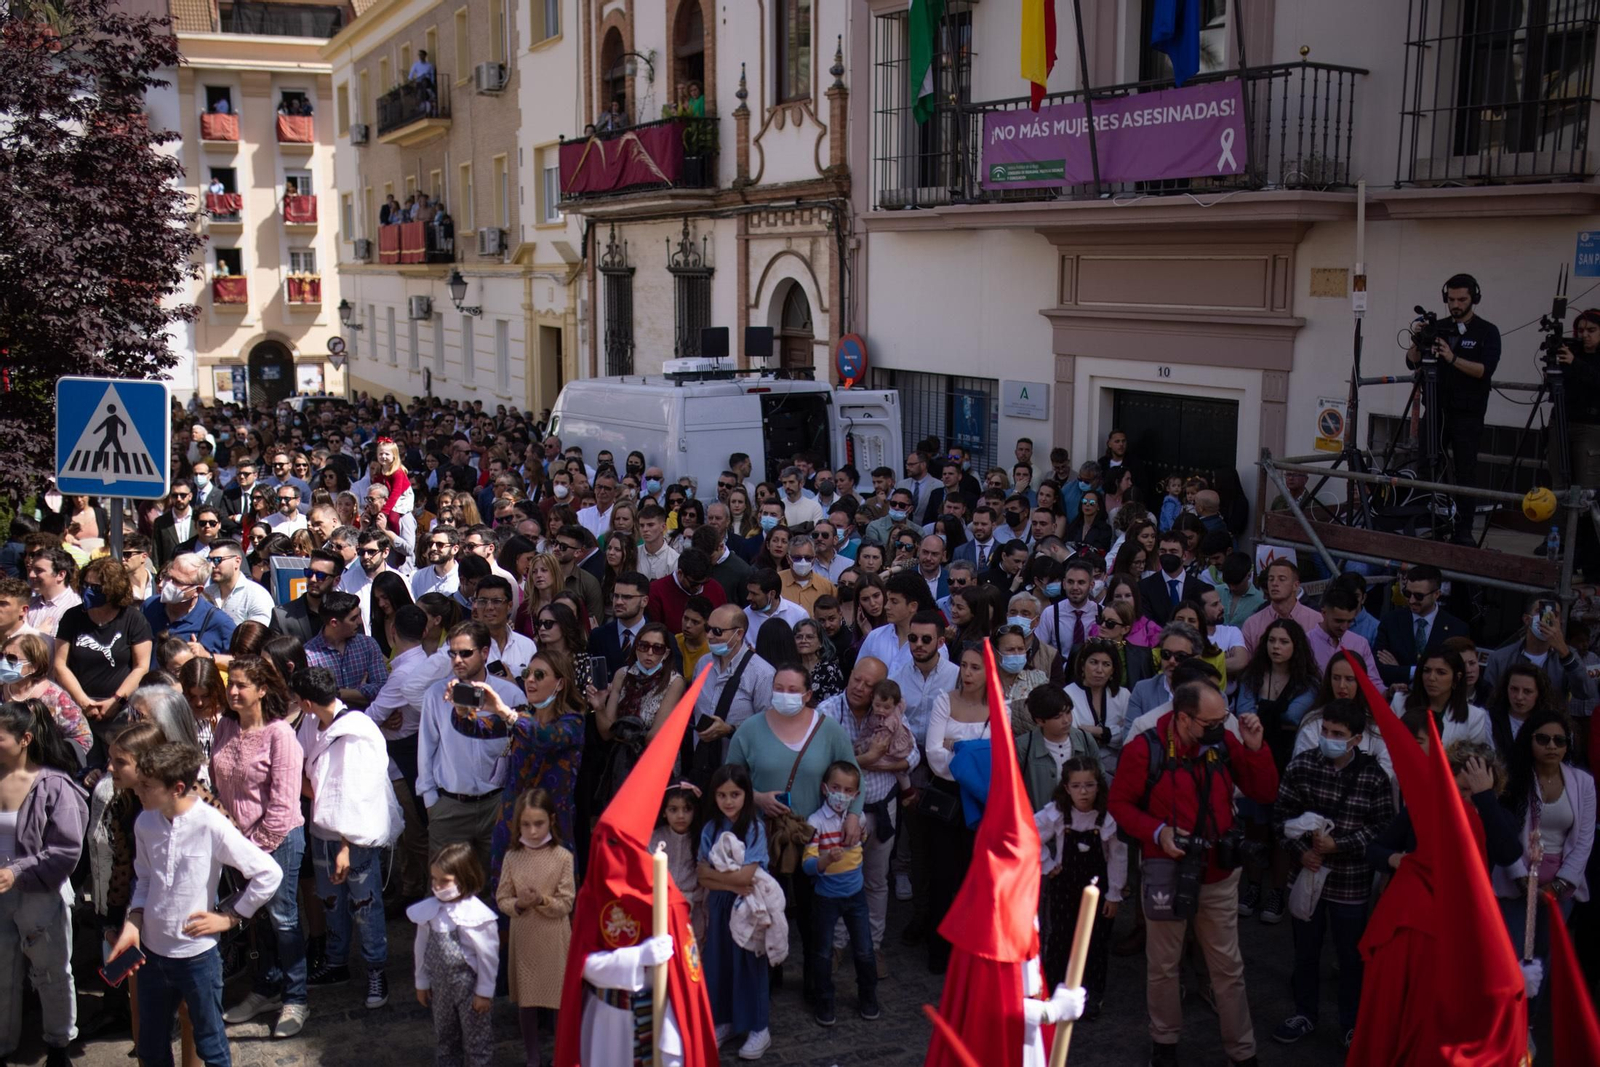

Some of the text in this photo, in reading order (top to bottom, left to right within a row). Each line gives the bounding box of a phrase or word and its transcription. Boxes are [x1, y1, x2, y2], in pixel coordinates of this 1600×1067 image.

[991, 98, 1236, 145] ¡NO MÁS MUJERES ASESINADAS!
[1578, 253, 1594, 266] SAN
[1158, 366, 1171, 378] 10
